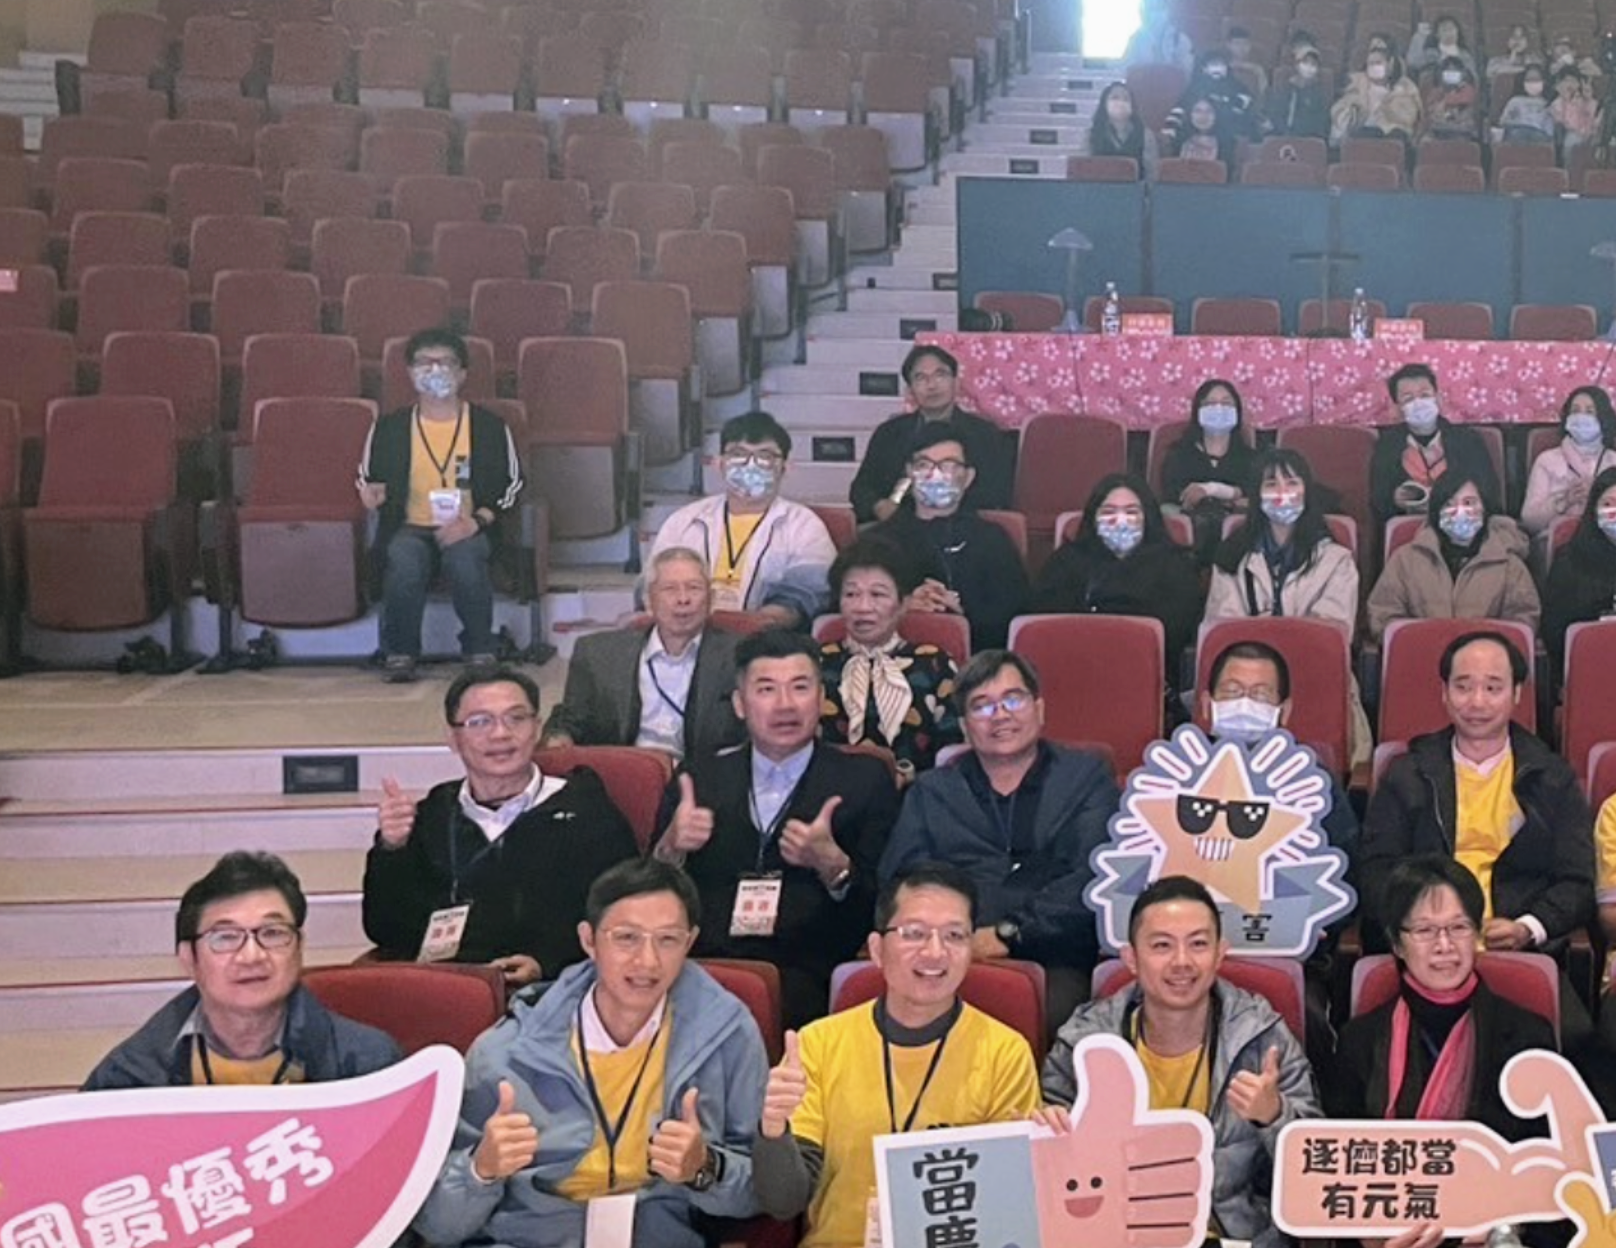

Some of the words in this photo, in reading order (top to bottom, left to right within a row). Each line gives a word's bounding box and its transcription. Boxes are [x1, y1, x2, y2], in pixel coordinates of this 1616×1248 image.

[1302, 1138, 1456, 1176] 逐儕都當
[1321, 1182, 1440, 1220] 有元氣
